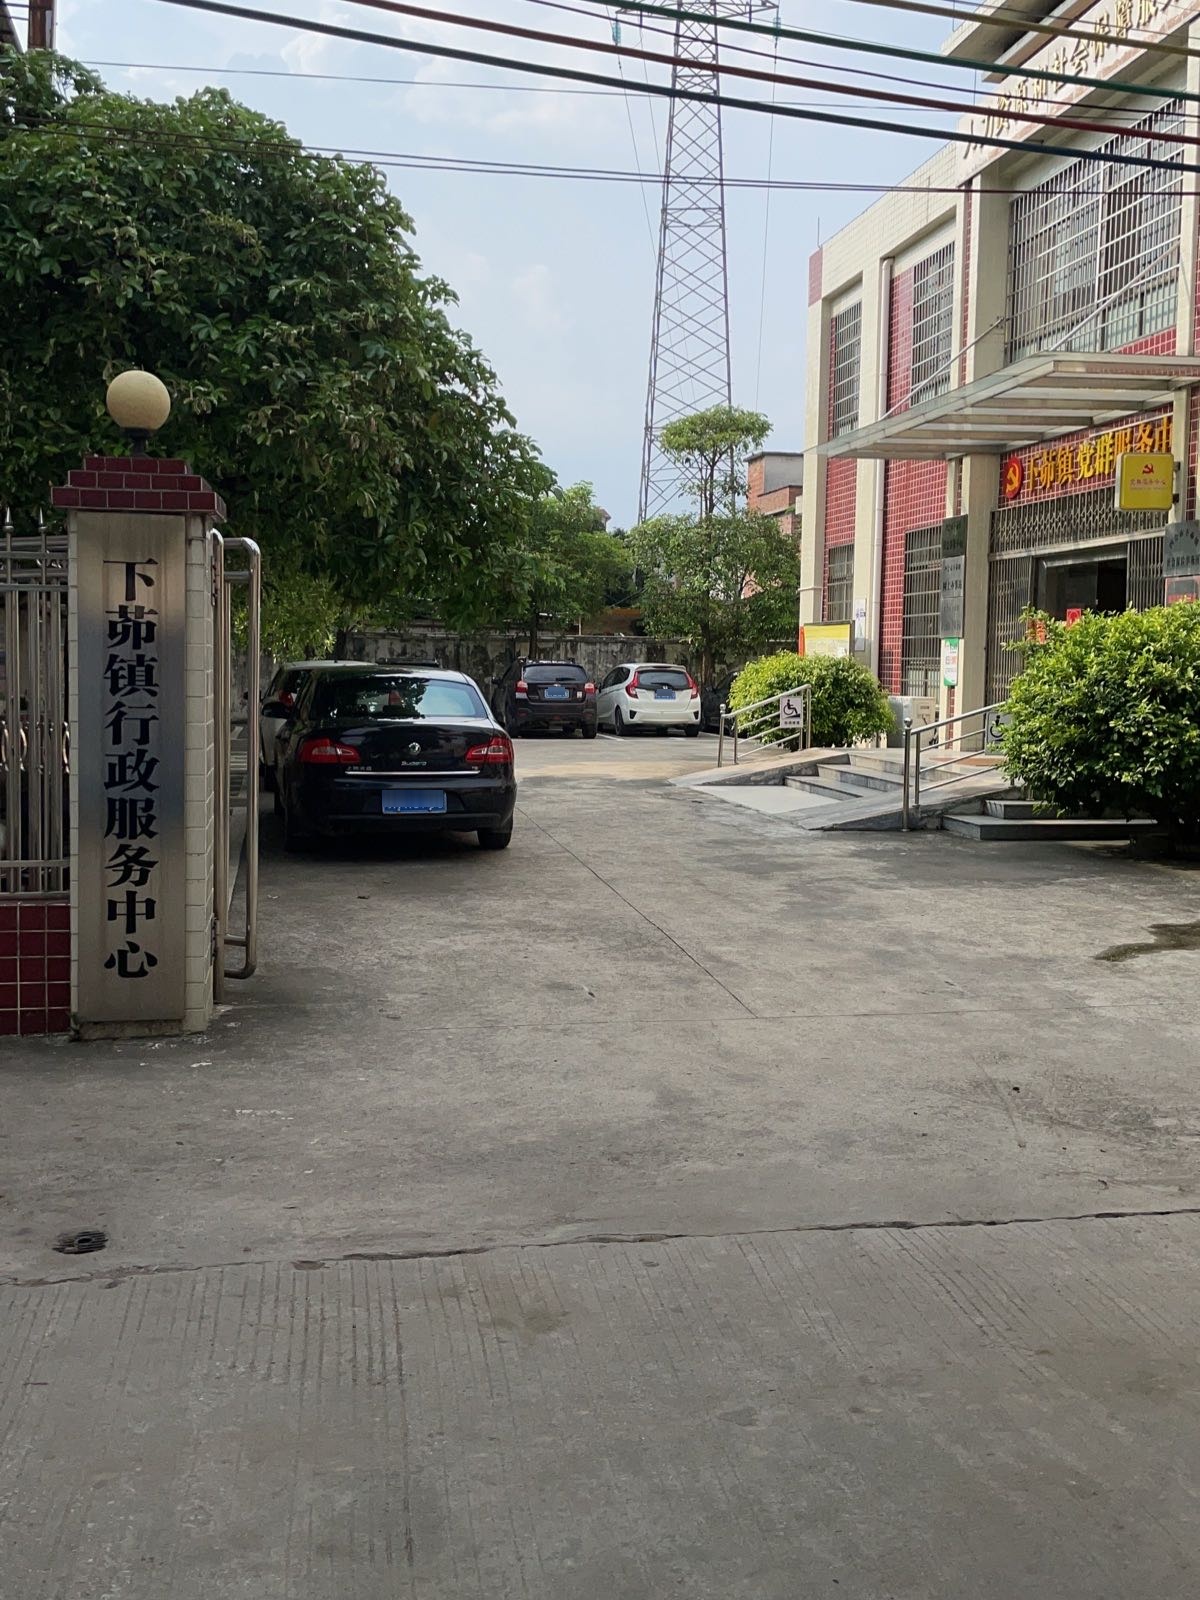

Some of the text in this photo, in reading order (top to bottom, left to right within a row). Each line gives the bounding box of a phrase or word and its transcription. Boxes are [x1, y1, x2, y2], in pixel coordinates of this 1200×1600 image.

[103, 557, 160, 978] 下茆镇行政服务中心
